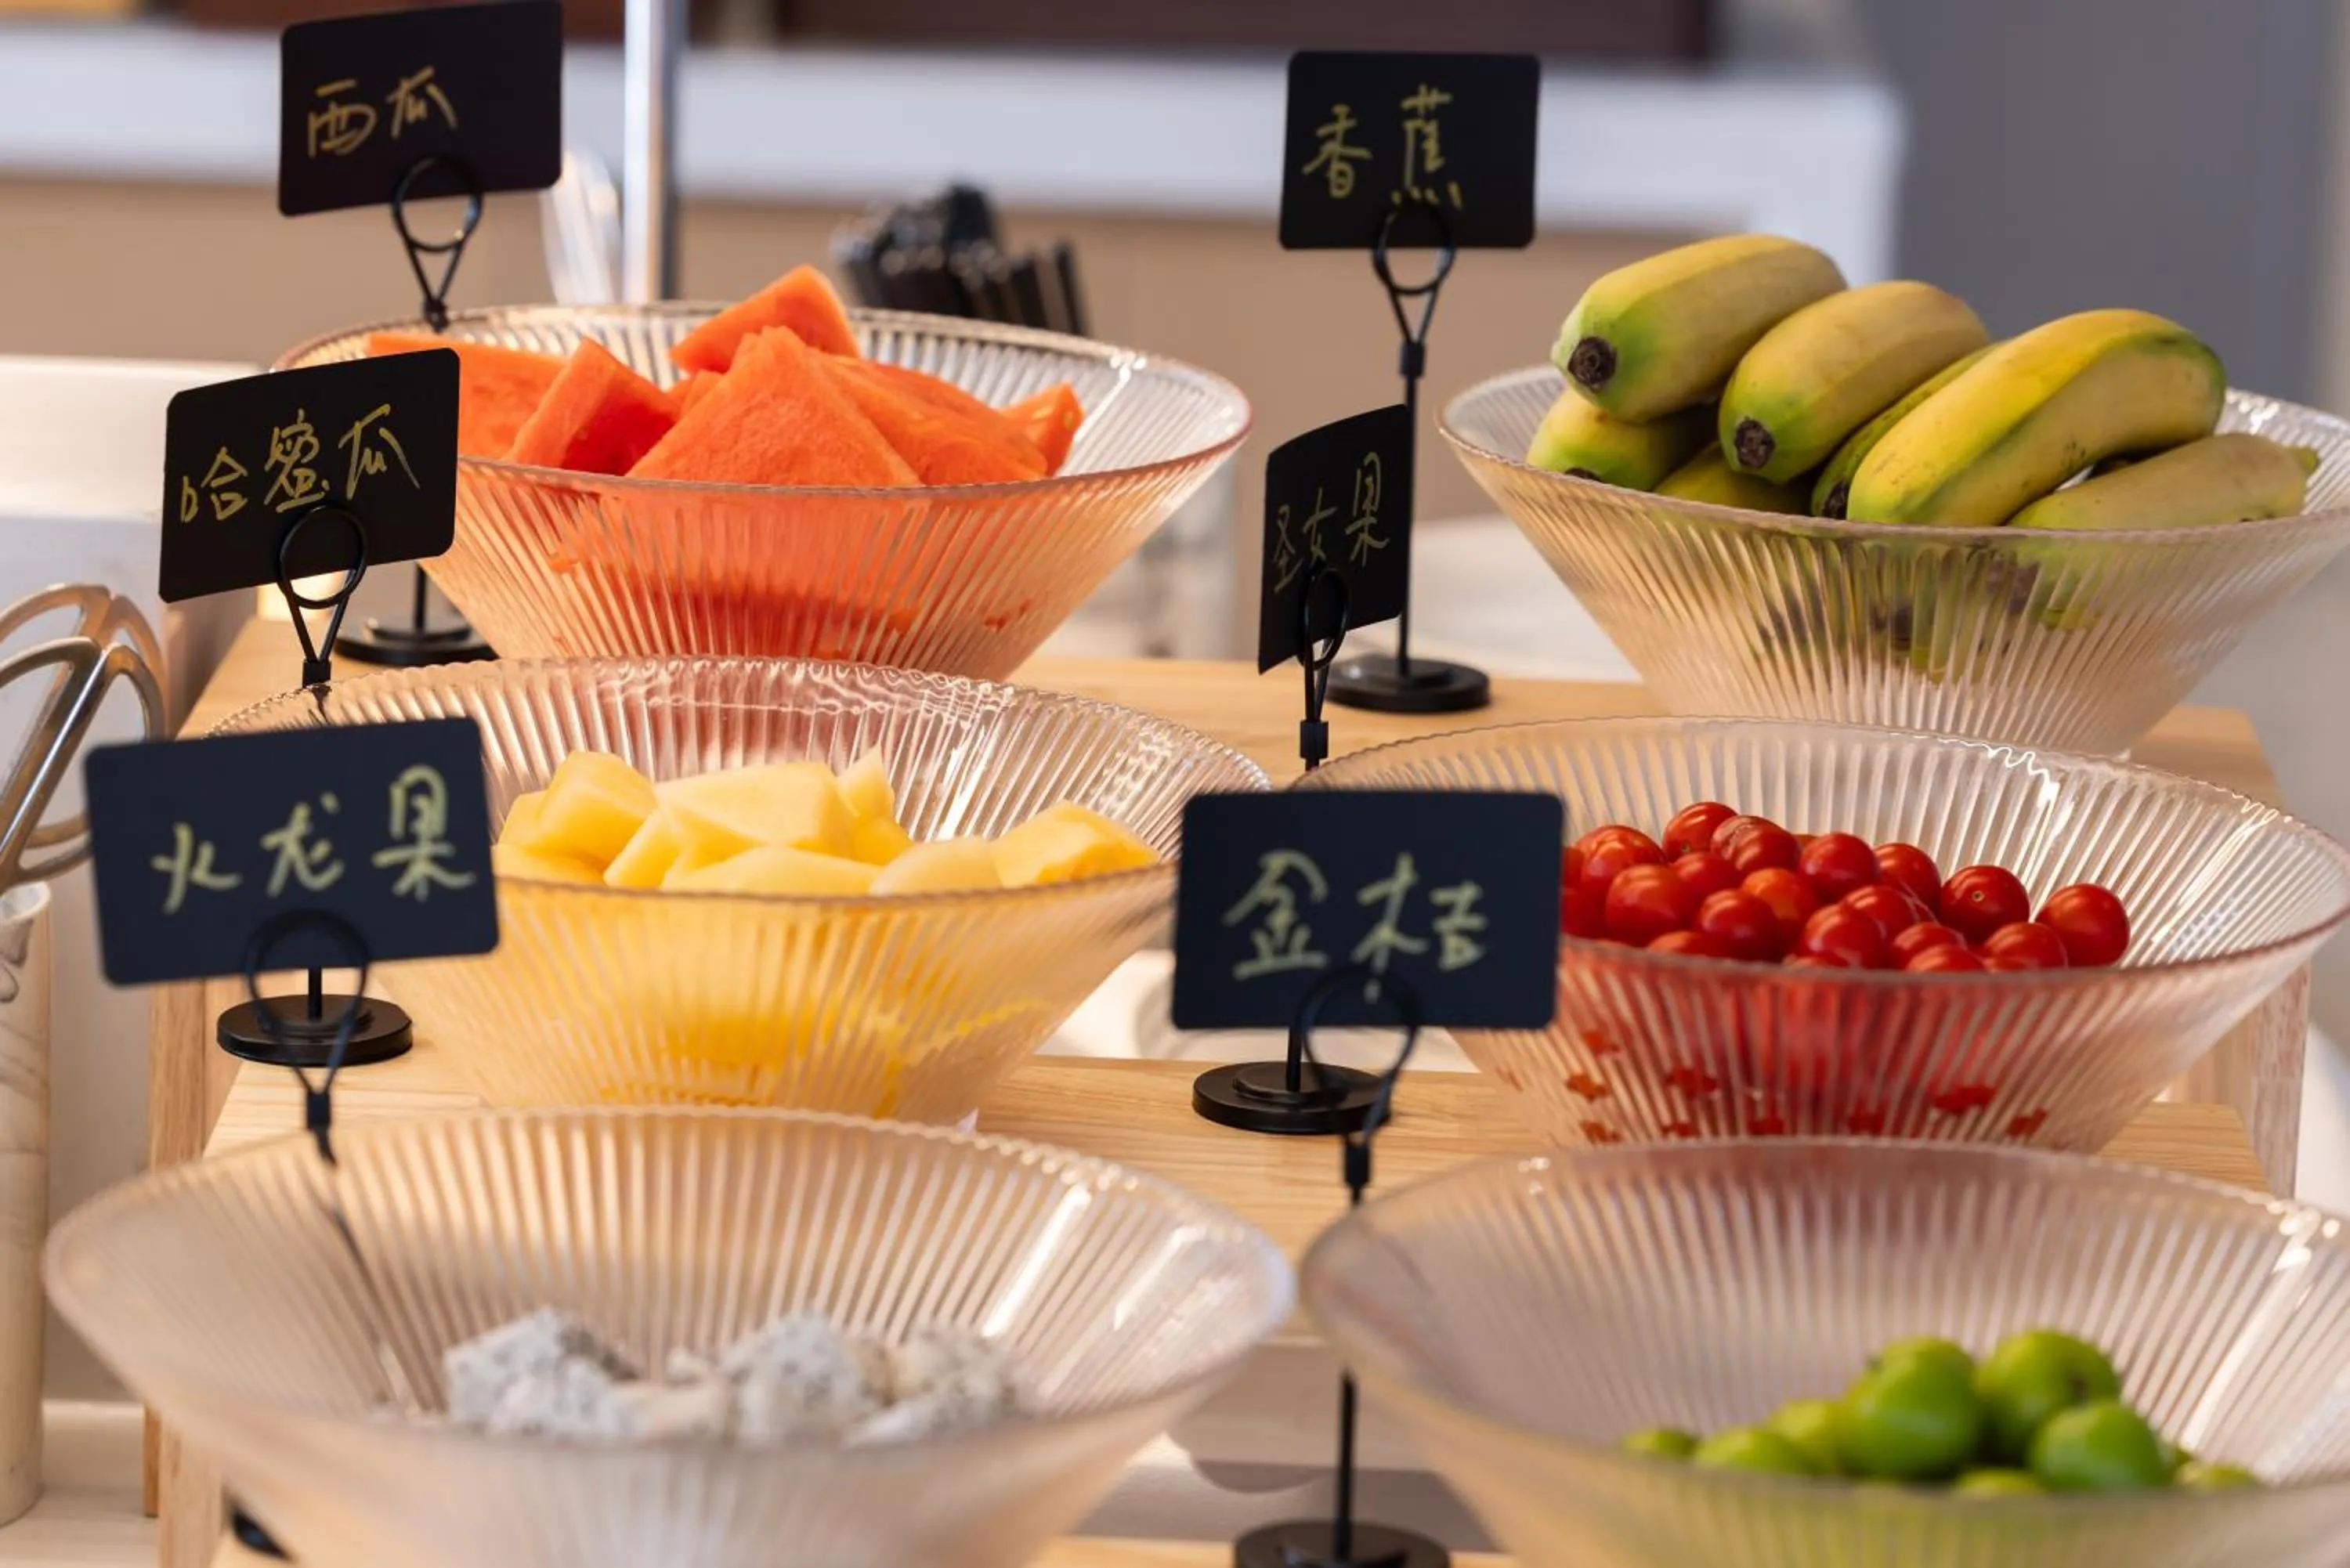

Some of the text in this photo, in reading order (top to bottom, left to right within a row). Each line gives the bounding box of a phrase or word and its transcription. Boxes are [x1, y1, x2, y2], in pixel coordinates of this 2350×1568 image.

[307, 66, 458, 159] 西瓜
[1301, 82, 1463, 211] 香蕉
[1273, 450, 1390, 594] 圣女果
[152, 764, 476, 915] 火龙果
[1222, 848, 1487, 1003] 金桔
